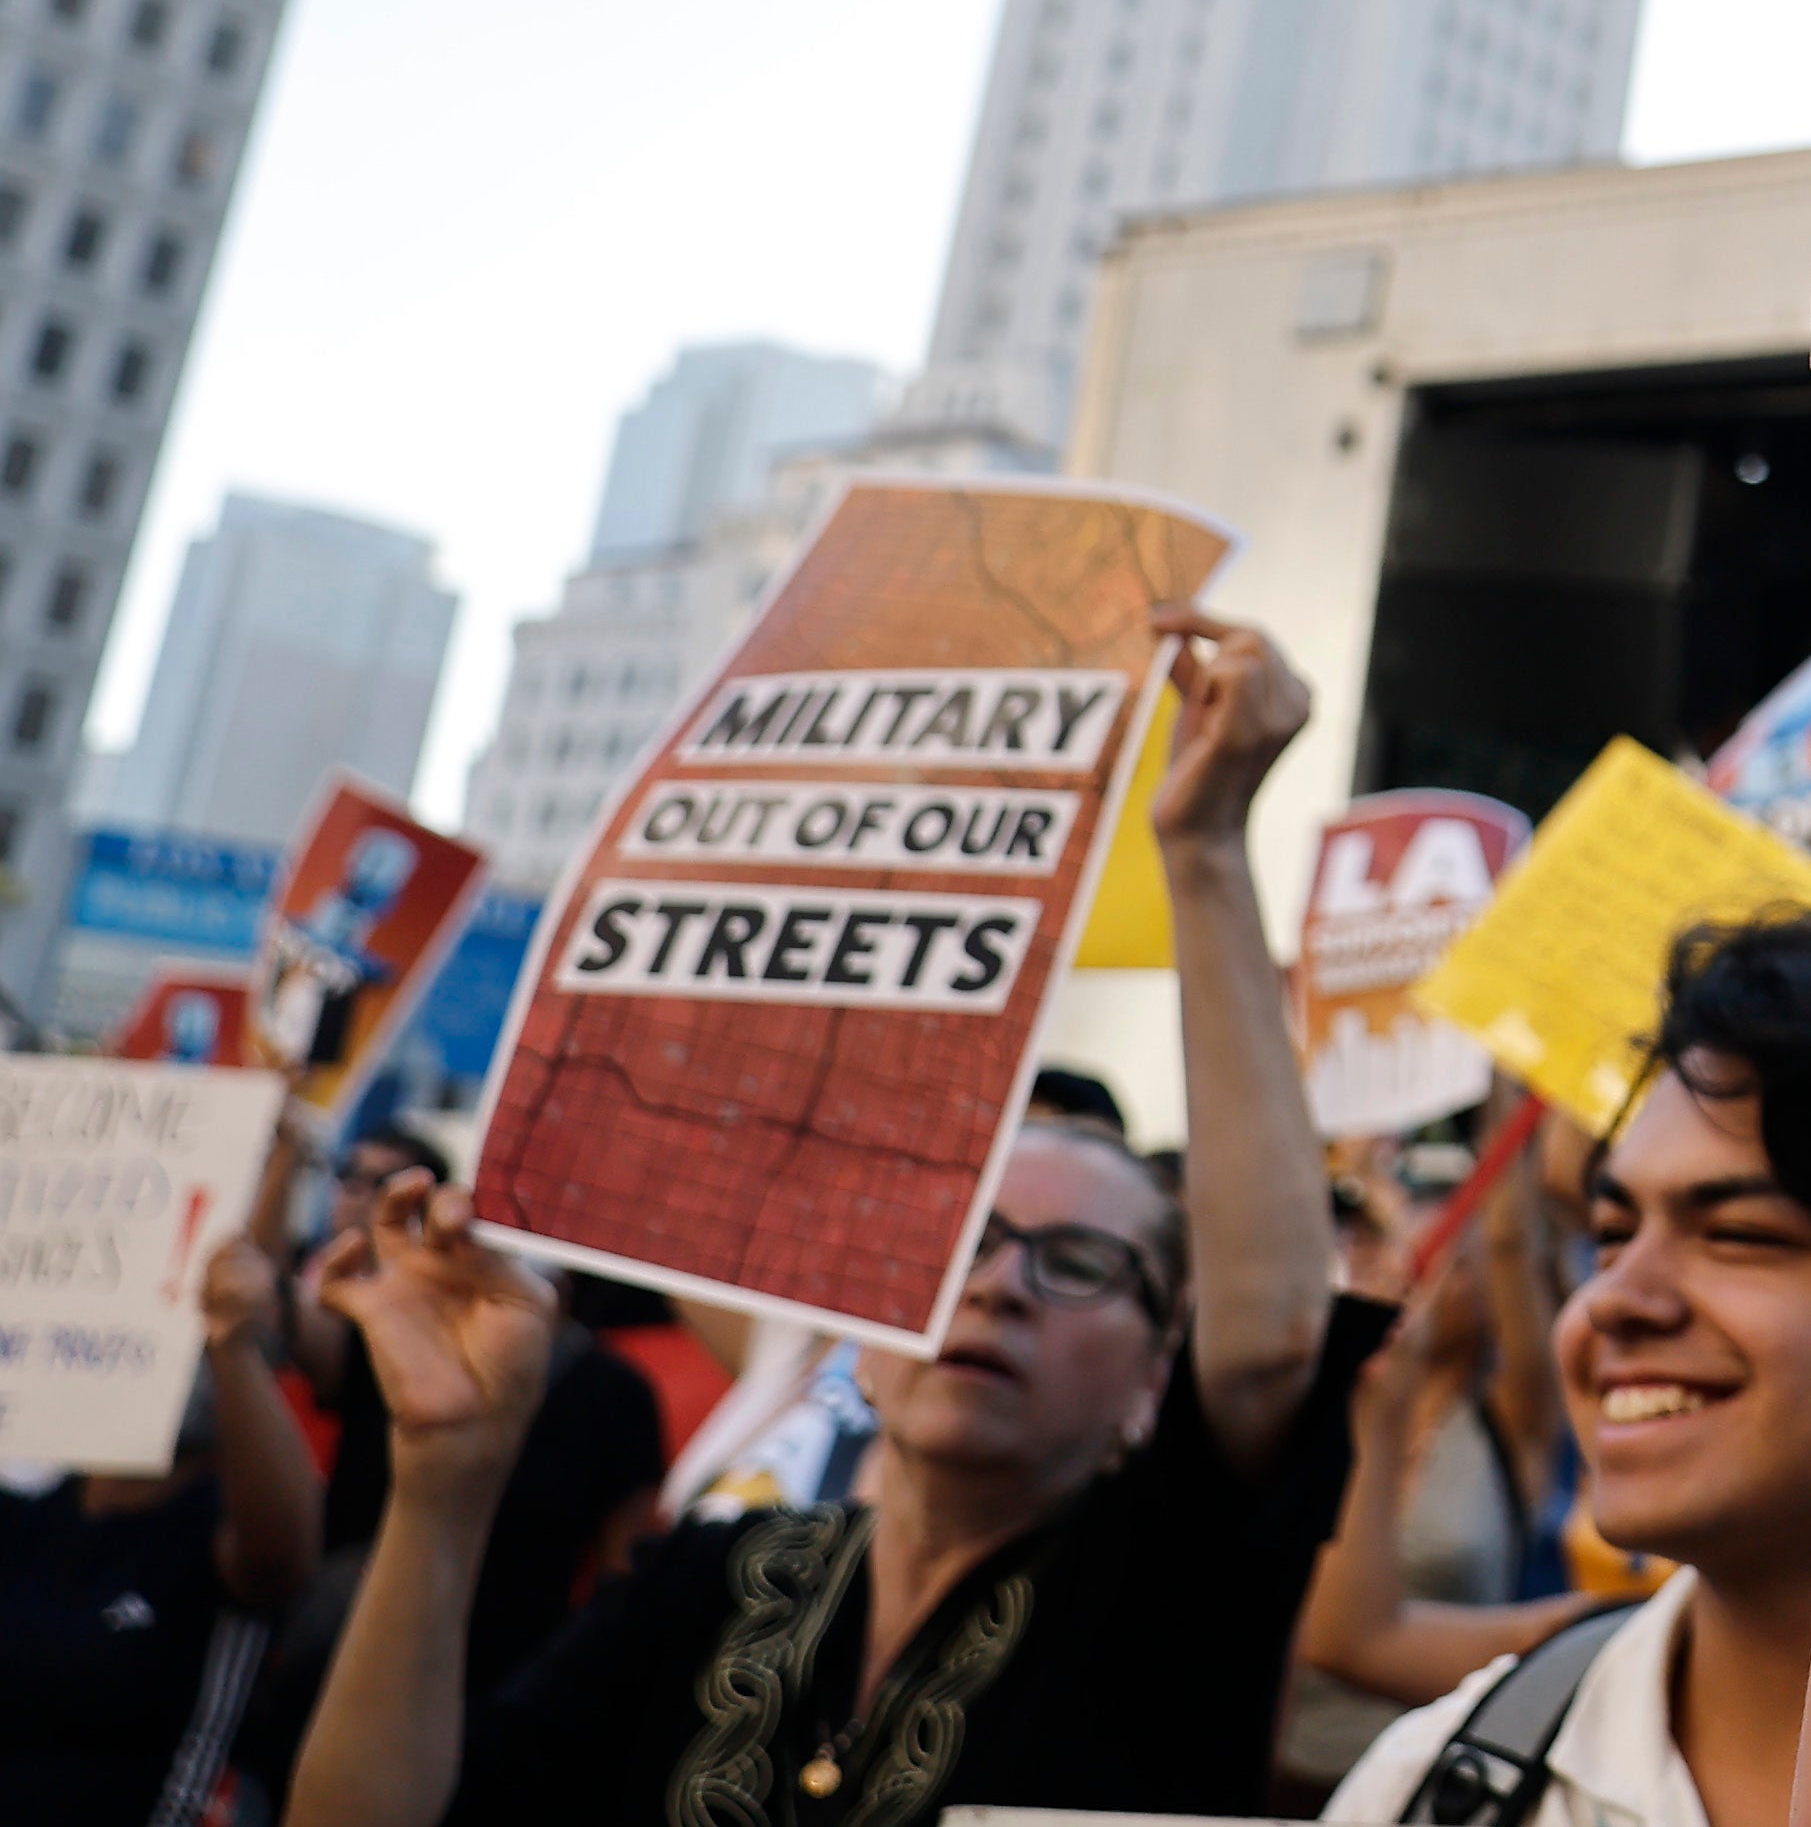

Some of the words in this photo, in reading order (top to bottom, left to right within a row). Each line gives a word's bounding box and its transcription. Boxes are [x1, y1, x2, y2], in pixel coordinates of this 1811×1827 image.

[700, 680, 1107, 756] MILITARY
[641, 793, 787, 847] OUT
[795, 799, 904, 853] OF
[900, 802, 1054, 860] OUR
[1320, 817, 1497, 918] LA
[575, 898, 1021, 995] STREETS
